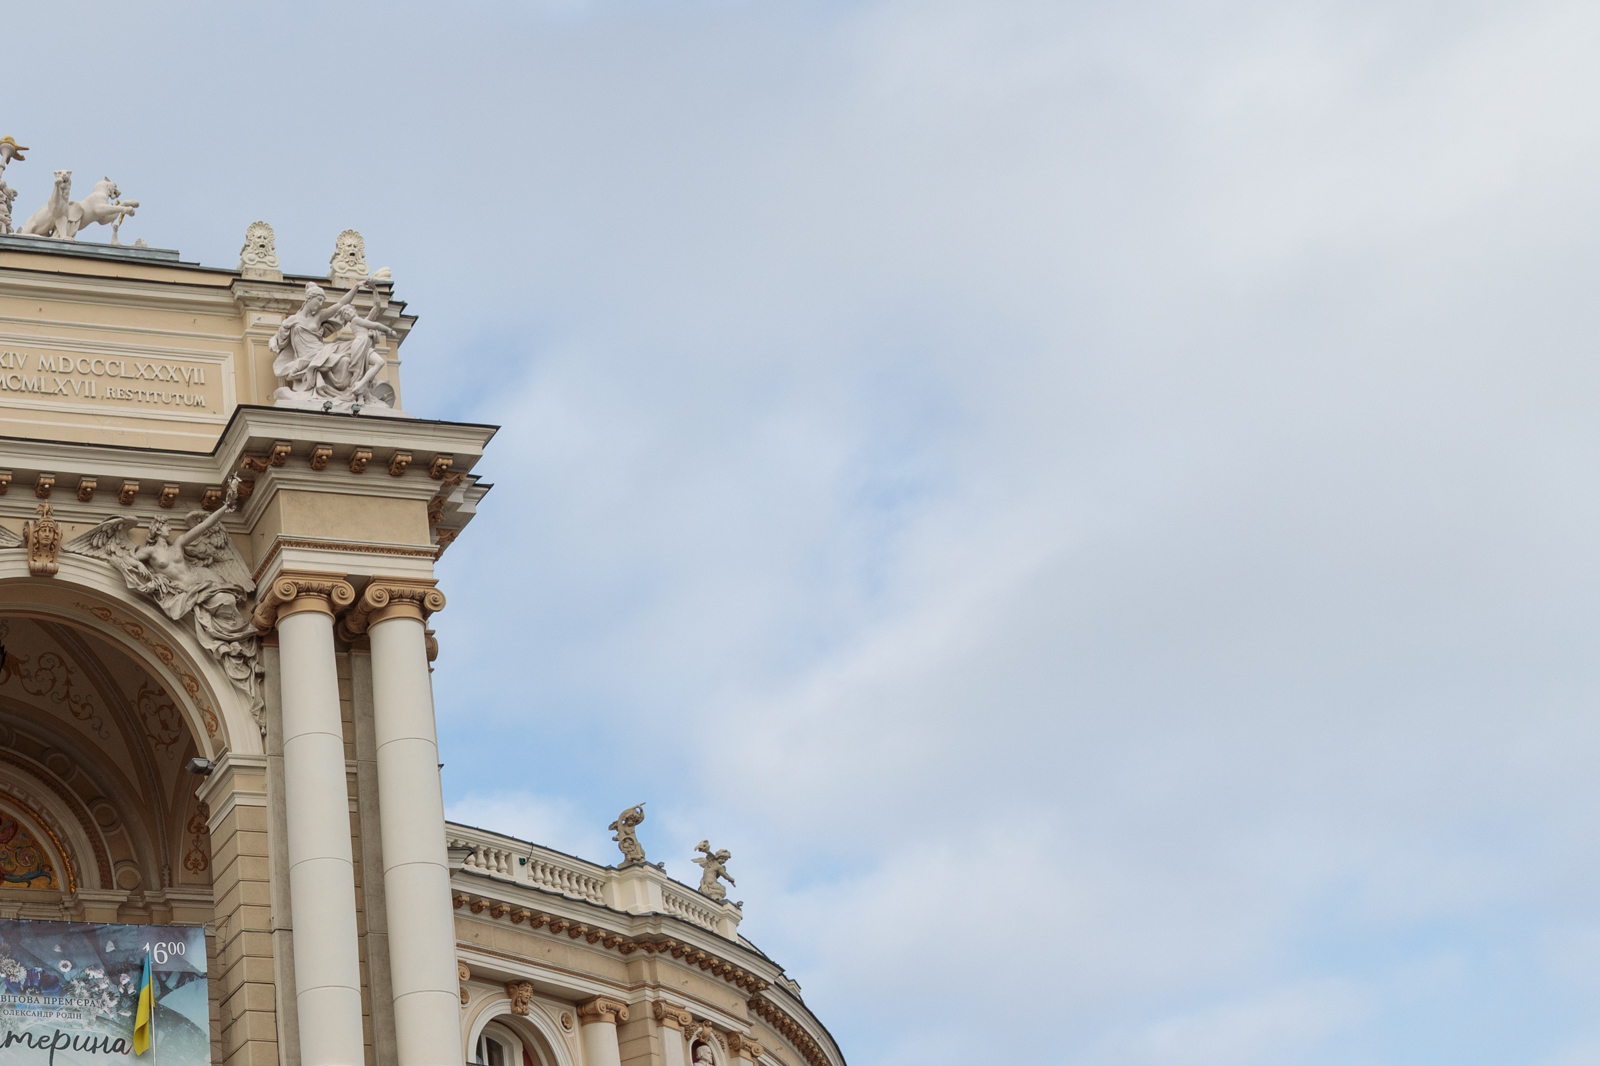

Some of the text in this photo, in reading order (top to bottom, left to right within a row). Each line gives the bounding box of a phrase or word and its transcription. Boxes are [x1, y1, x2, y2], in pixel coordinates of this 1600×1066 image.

[37, 354, 206, 385] MDCCCLXXXVII
[105, 385, 206, 407] RESTITUTUM
[2, 1009, 82, 1020] ОЛЕКСАНДР РОДІН
